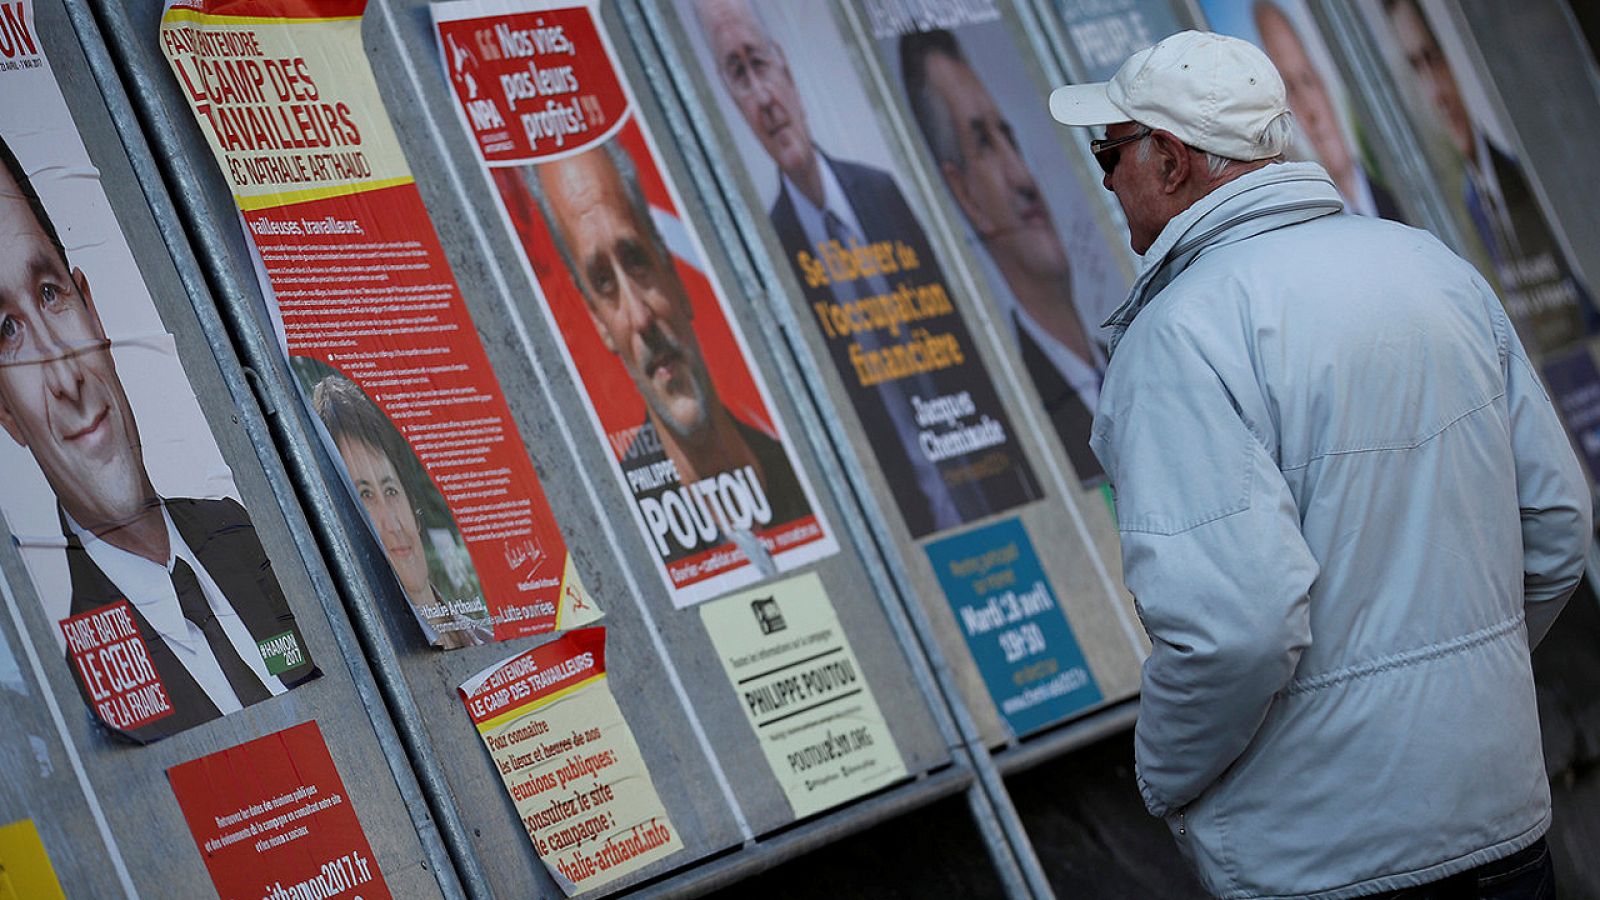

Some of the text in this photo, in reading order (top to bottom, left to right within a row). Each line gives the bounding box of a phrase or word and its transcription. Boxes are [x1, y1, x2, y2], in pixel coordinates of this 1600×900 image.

[163, 28, 196, 56] FAIR
[529, 18, 576, 56] vies,
[174, 56, 319, 105] L CAMP DES
[500, 60, 579, 112] pas leurs
[196, 101, 361, 152] TAVAILLEURS
[466, 98, 506, 131] NPA
[244, 155, 311, 186] NATHALIE
[308, 151, 371, 182] ARTHAUD
[249, 216, 365, 237] vailleuses, travailleurs,
[609, 422, 665, 462] VOTEZ
[626, 458, 681, 493] PHILIPPE
[638, 465, 773, 556] POUTOU
[64, 606, 136, 654] FAIRE BATTRE
[259, 634, 298, 660] #HAMON
[77, 637, 156, 701] LE CŒUR
[283, 648, 303, 667] 2017
[490, 654, 538, 687] ENTENDRE
[470, 651, 594, 718] LE CAMP DES TRAVAILLEURS
[744, 658, 856, 717] PHILIPPE POUTOU
[98, 683, 170, 729] DE LA FRANCE
[487, 720, 549, 752] Pour connaître
[510, 752, 535, 771] lieux
[534, 749, 545, 763] et
[541, 737, 573, 757] heures
[572, 730, 585, 748] de
[584, 727, 601, 743] nos
[510, 773, 557, 801] éunions
[574, 790, 591, 812] le
[589, 782, 614, 806] site
[557, 817, 670, 883] halie-arthaud.info
[263, 850, 372, 900] ithamon2017.fr
